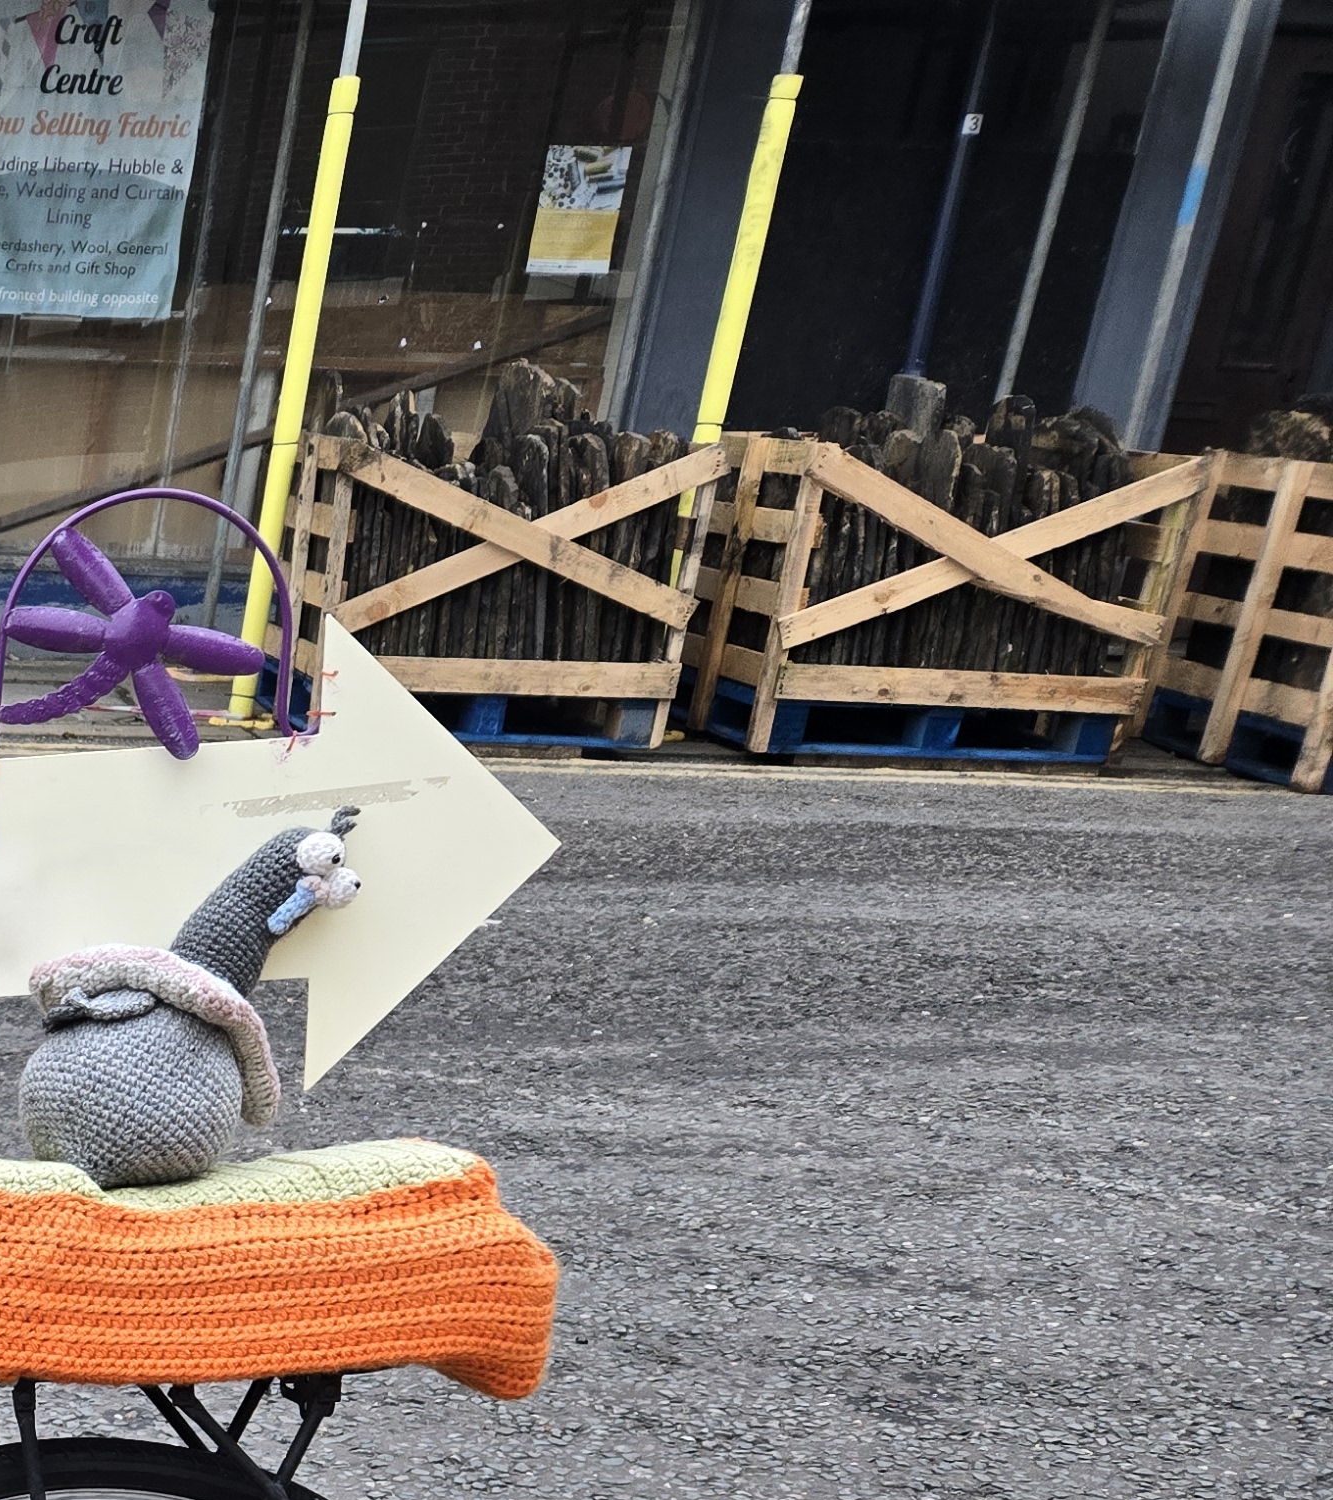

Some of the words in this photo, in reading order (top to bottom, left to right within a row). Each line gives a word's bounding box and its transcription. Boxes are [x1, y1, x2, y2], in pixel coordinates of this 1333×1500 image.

[55, 14, 123, 54] Craft
[39, 64, 124, 95] Centre
[31, 109, 112, 145] Selling
[118, 112, 192, 139] Fabric
[969, 115, 980, 131] 3
[43, 156, 103, 178] Liberty,
[108, 158, 166, 175] Hubble
[171, 158, 184, 174] &
[16, 181, 85, 202] Wadding
[91, 183, 120, 200] and
[125, 184, 185, 201] Curtain
[46, 208, 93, 229] Lining
[71, 240, 112, 256] Wool,
[117, 241, 169, 256] General
[5, 259, 43, 272] Crafts
[47, 261, 71, 274] and
[75, 262, 100, 275] Gift
[104, 262, 136, 279] Shop
[49, 287, 99, 305] building
[102, 291, 160, 309] opposite
